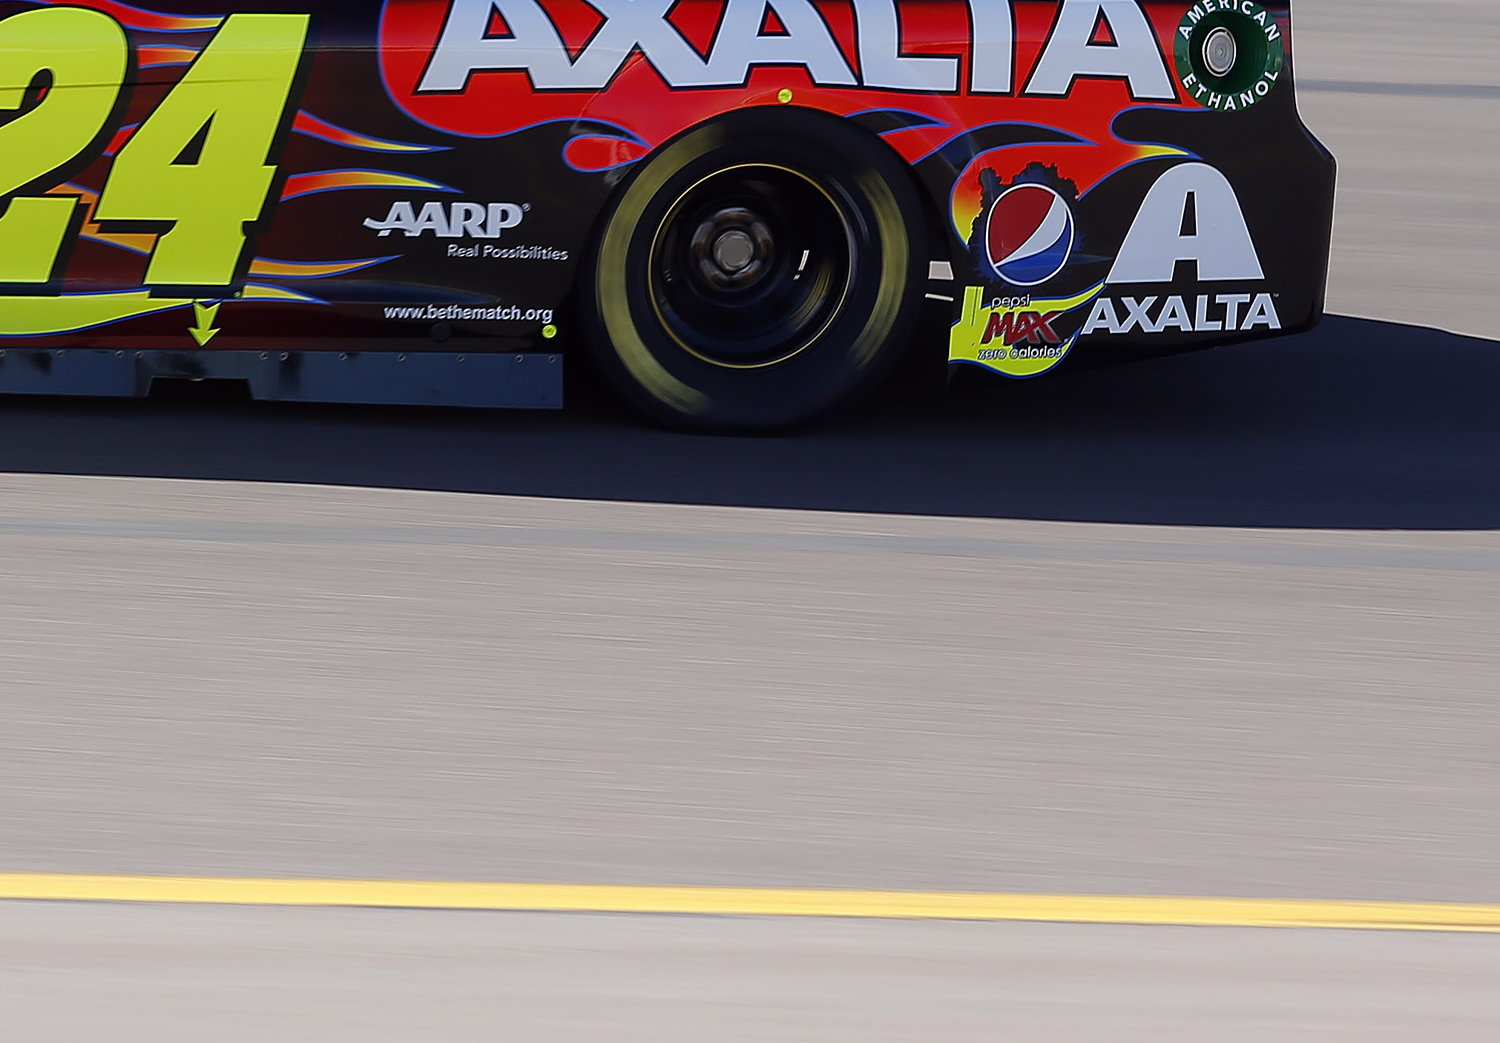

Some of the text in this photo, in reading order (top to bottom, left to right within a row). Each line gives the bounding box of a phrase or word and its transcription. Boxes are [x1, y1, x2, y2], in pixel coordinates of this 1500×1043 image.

[1182, 70, 1279, 111] ETHANOL
[362, 201, 524, 238] AARP
[1105, 162, 1265, 284] A
[447, 244, 569, 261] Real Possibilities
[384, 304, 553, 324] www.bethematch.org
[991, 294, 1031, 309] pepsi
[1080, 293, 1281, 335] AXALTA
[980, 311, 1066, 346] MAX
[978, 345, 1063, 360] zero calories
